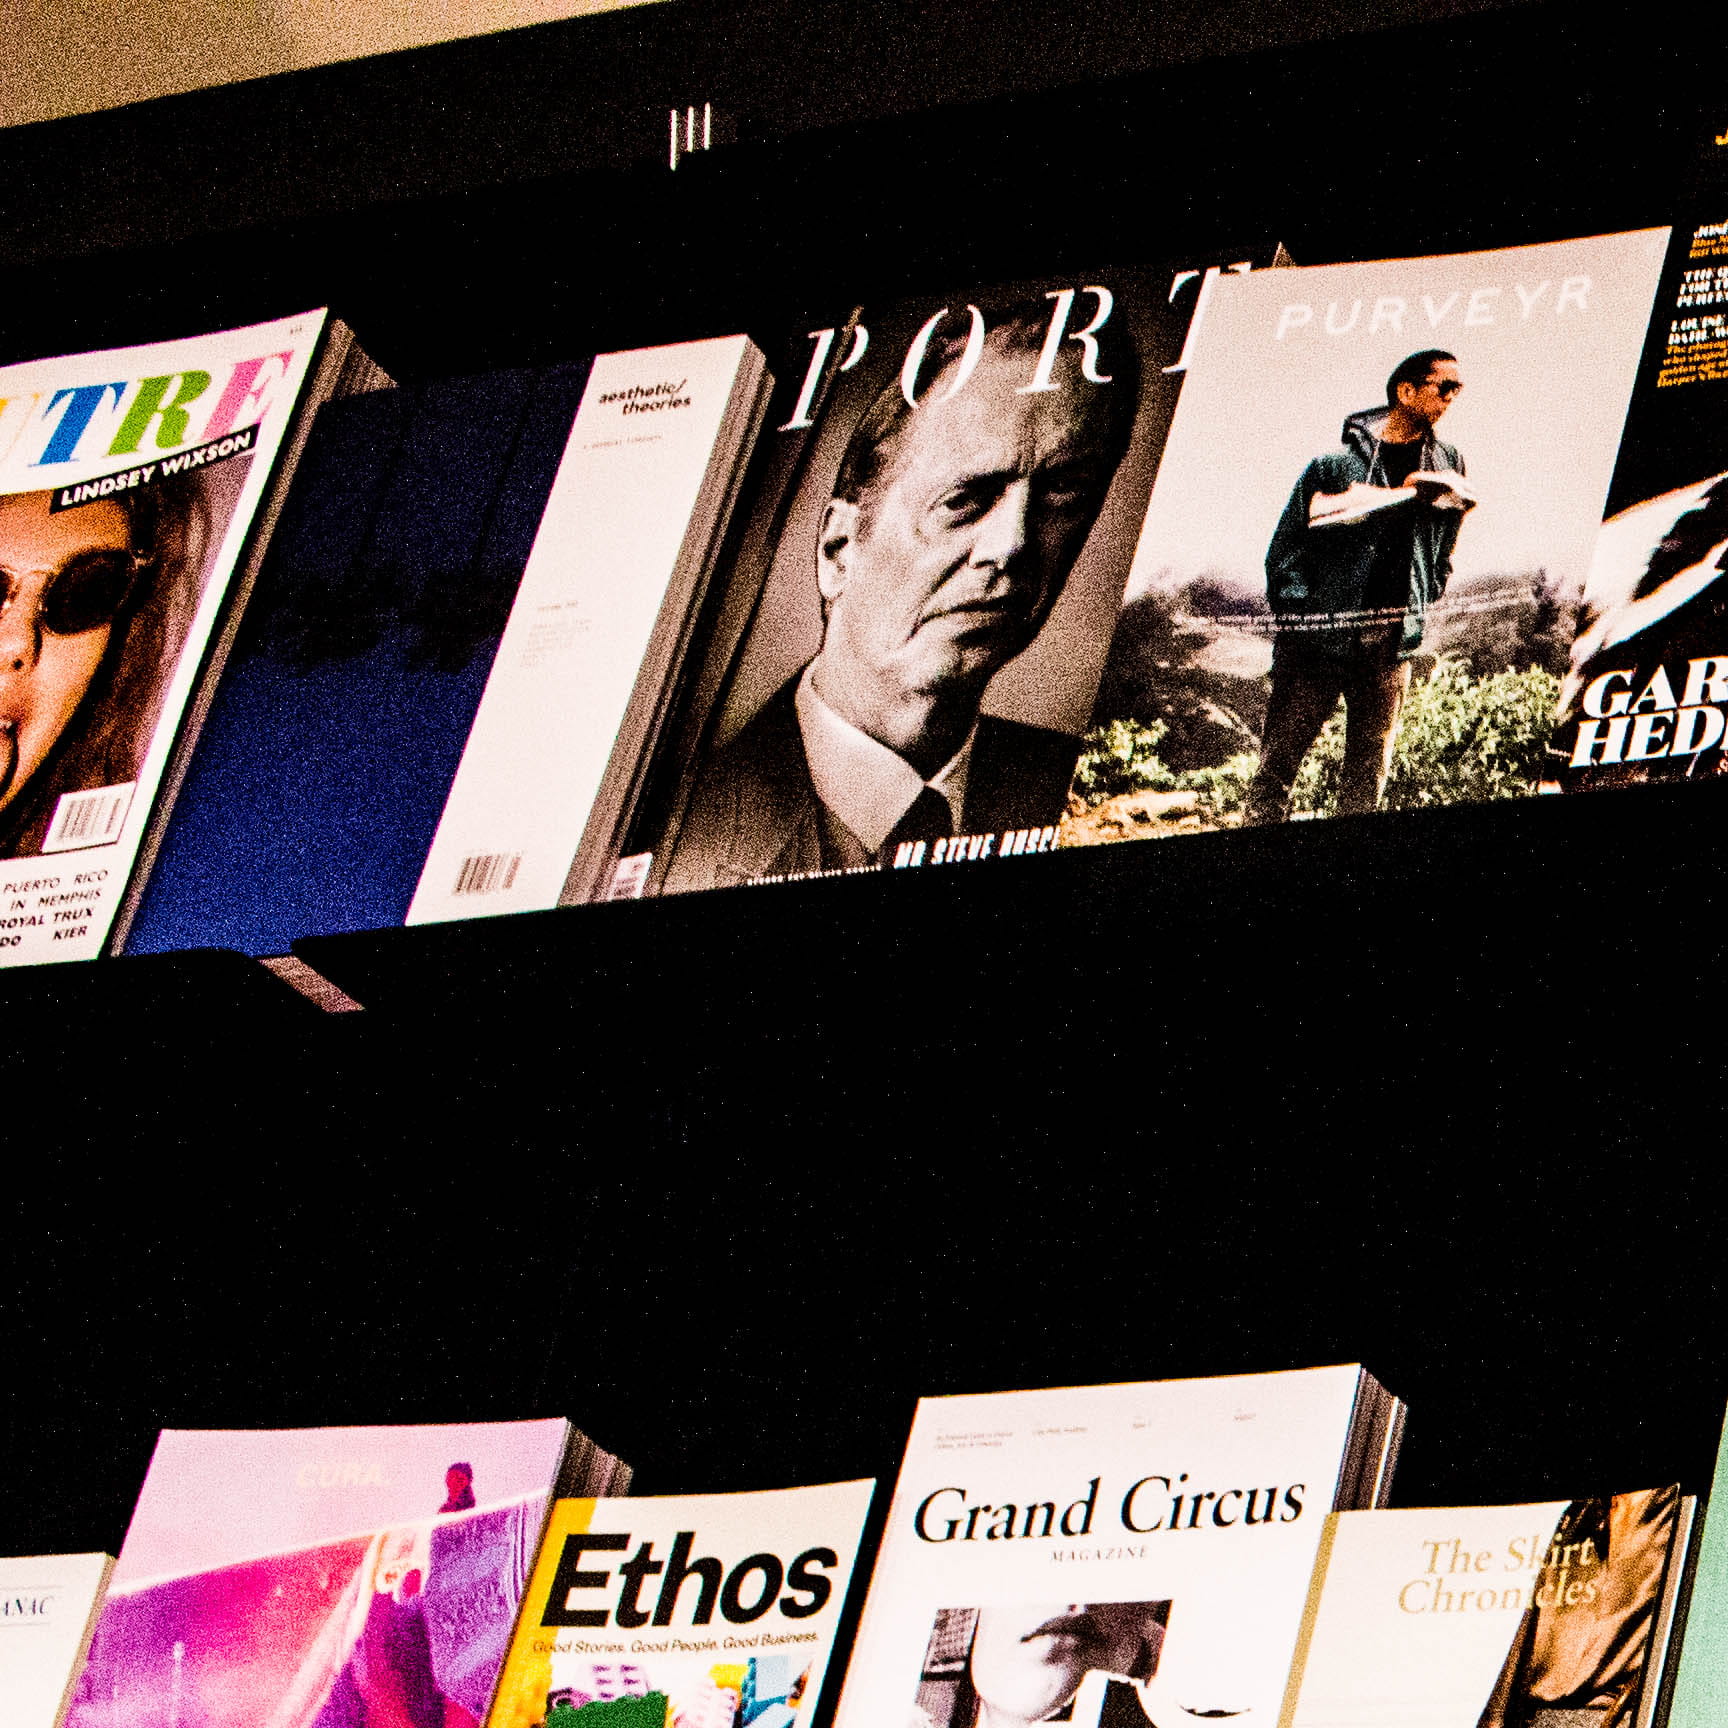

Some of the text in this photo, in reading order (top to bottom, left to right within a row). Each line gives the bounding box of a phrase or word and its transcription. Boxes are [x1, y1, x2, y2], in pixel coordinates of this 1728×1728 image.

[1275, 273, 1592, 342] PURVEYR
[777, 260, 1251, 432] PORT
[600, 378, 688, 404] aesthetic/
[622, 397, 691, 415] theories
[61, 431, 251, 506] LINDSEY WIXSON
[3, 869, 109, 893] PUERTO RICO
[10, 888, 103, 911] IN MEMPHIS
[53, 908, 94, 923] TRUX
[53, 925, 88, 940] KIER
[912, 1472, 1306, 1544] Grand Circus
[1050, 1545, 1148, 1563] MAGAZINE
[1422, 1532, 1596, 1576] The Skirt
[540, 1530, 839, 1631] Ethos
[1398, 1568, 1598, 1616] Chronicles
[532, 1639, 573, 1653] Good
[630, 1637, 668, 1653] Good
[722, 1633, 757, 1649] Good
